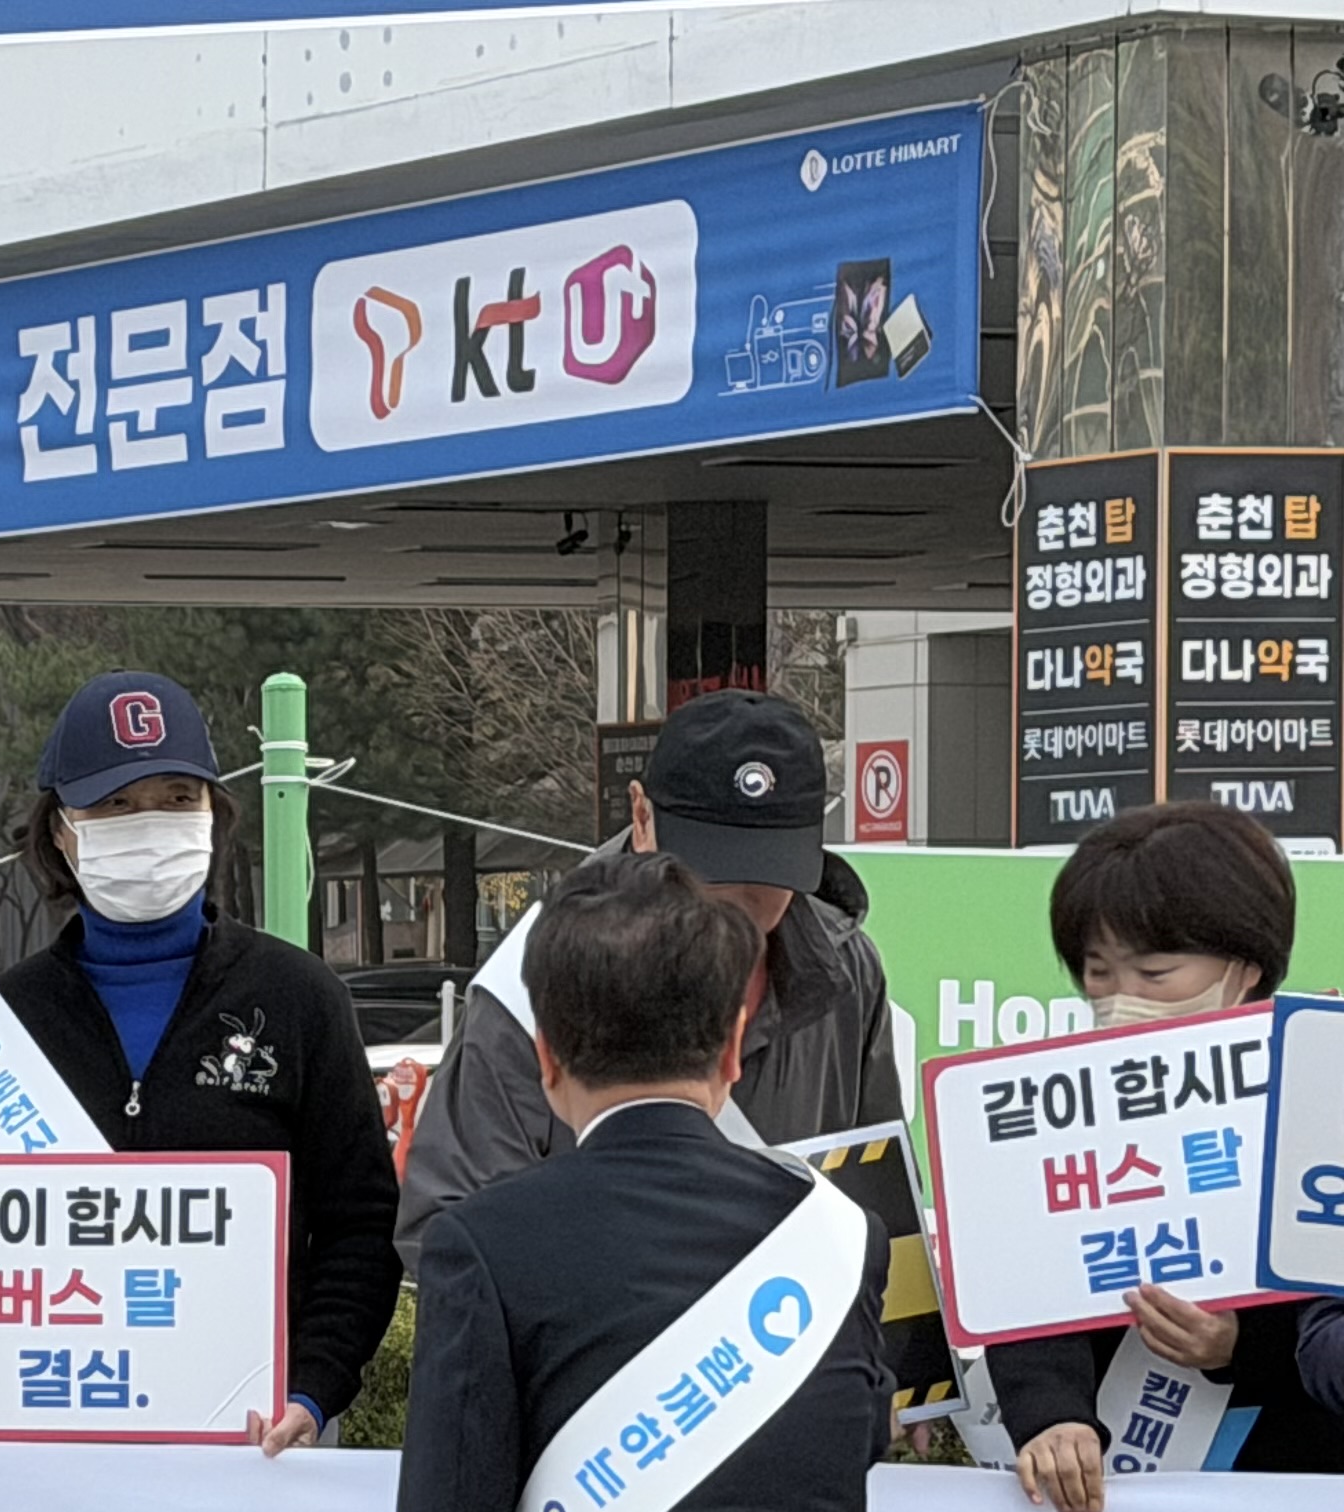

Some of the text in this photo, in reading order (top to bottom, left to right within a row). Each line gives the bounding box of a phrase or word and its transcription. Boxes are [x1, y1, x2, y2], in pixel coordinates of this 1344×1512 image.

[832, 133, 961, 174] LOTTE HIMART
[451, 267, 541, 402] kt
[18, 283, 288, 484] 전문점
[1037, 497, 1135, 551] 춘천 탑
[1196, 492, 1322, 540] 춘천 탑
[1025, 555, 1147, 610] 정형외과
[1181, 553, 1333, 599] 정형외과
[1025, 640, 1145, 691] 다나약국
[1181, 639, 1330, 683] 다나약국
[109, 691, 166, 749] G
[1023, 721, 1148, 761] 롯데하이마트
[1176, 718, 1334, 752] 롯데하이마트
[982, 1066, 1096, 1143] 같이
[1043, 1127, 1243, 1214] 버스 탈
[65, 1186, 233, 1247] 합시다
[1080, 1217, 1224, 1295] 결심.
[124, 1268, 182, 1328] 탈
[18, 1349, 150, 1409] 결심.
